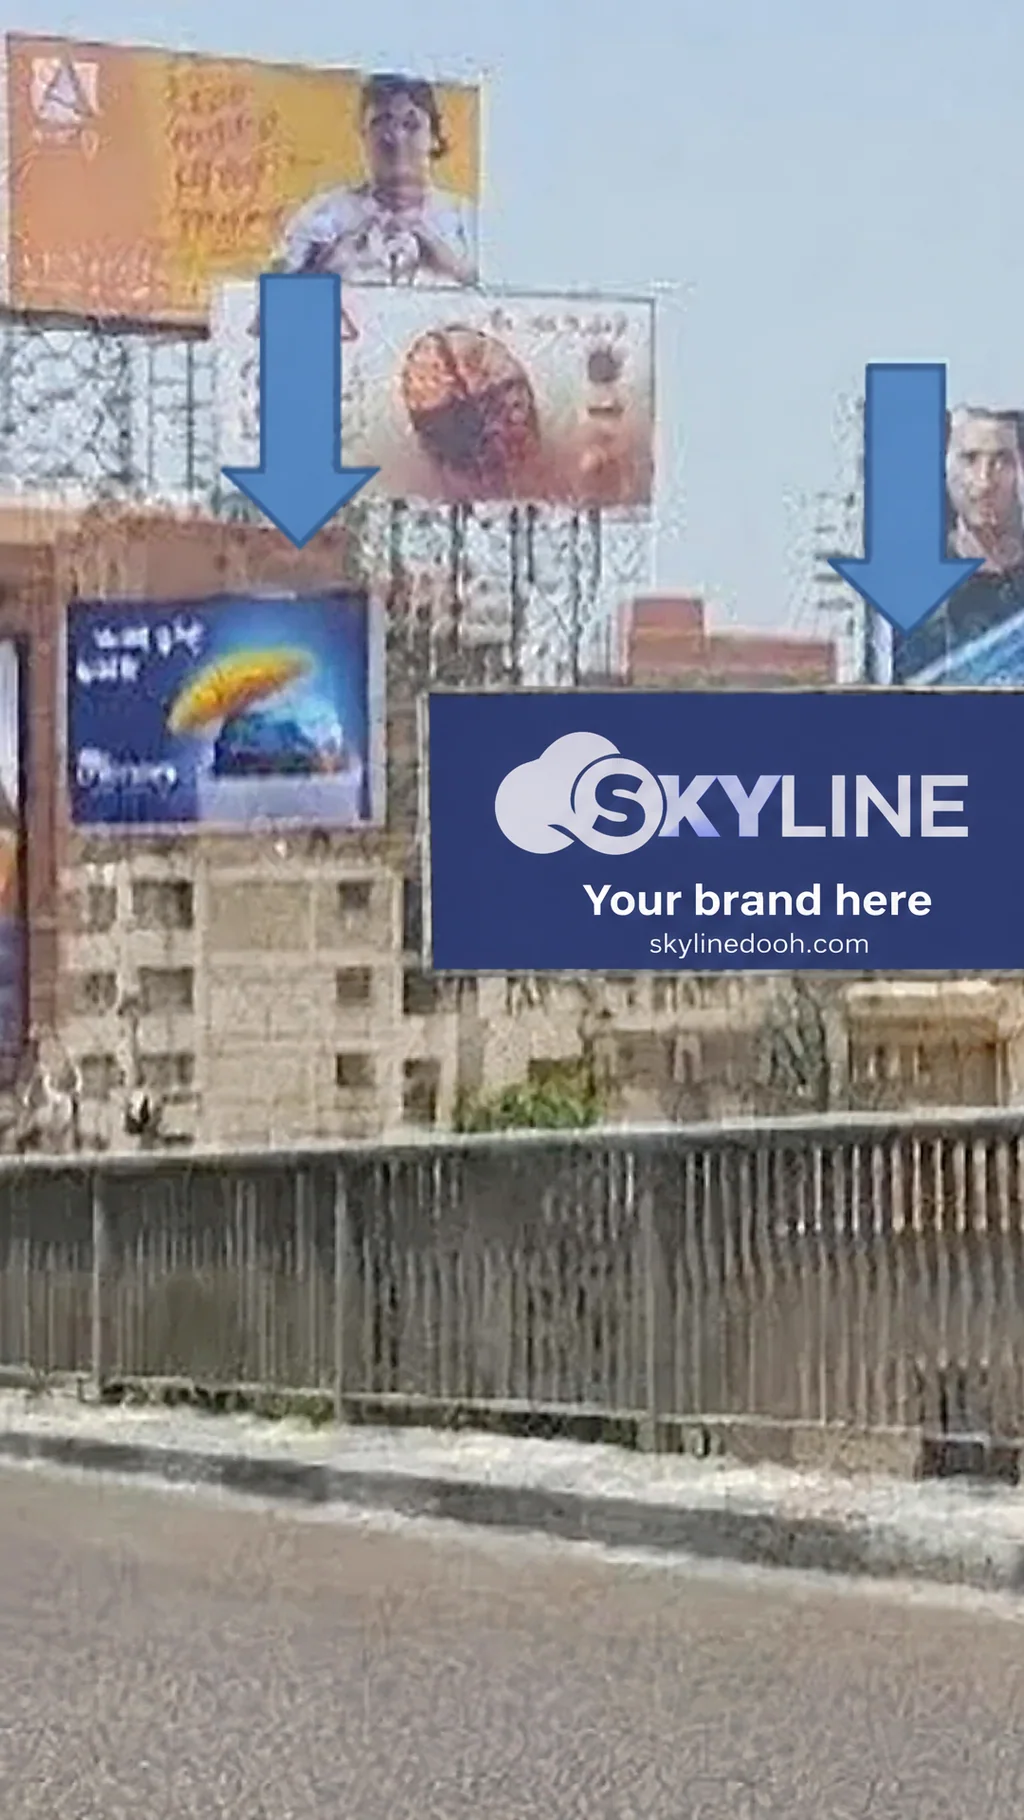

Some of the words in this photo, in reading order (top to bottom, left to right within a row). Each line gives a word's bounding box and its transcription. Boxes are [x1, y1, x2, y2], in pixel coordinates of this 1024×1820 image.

[591, 773, 969, 838] SKYLINE
[582, 883, 682, 917] Your
[695, 882, 821, 917] brand
[836, 882, 932, 917] here
[649, 931, 869, 959] skylinedooh.com
